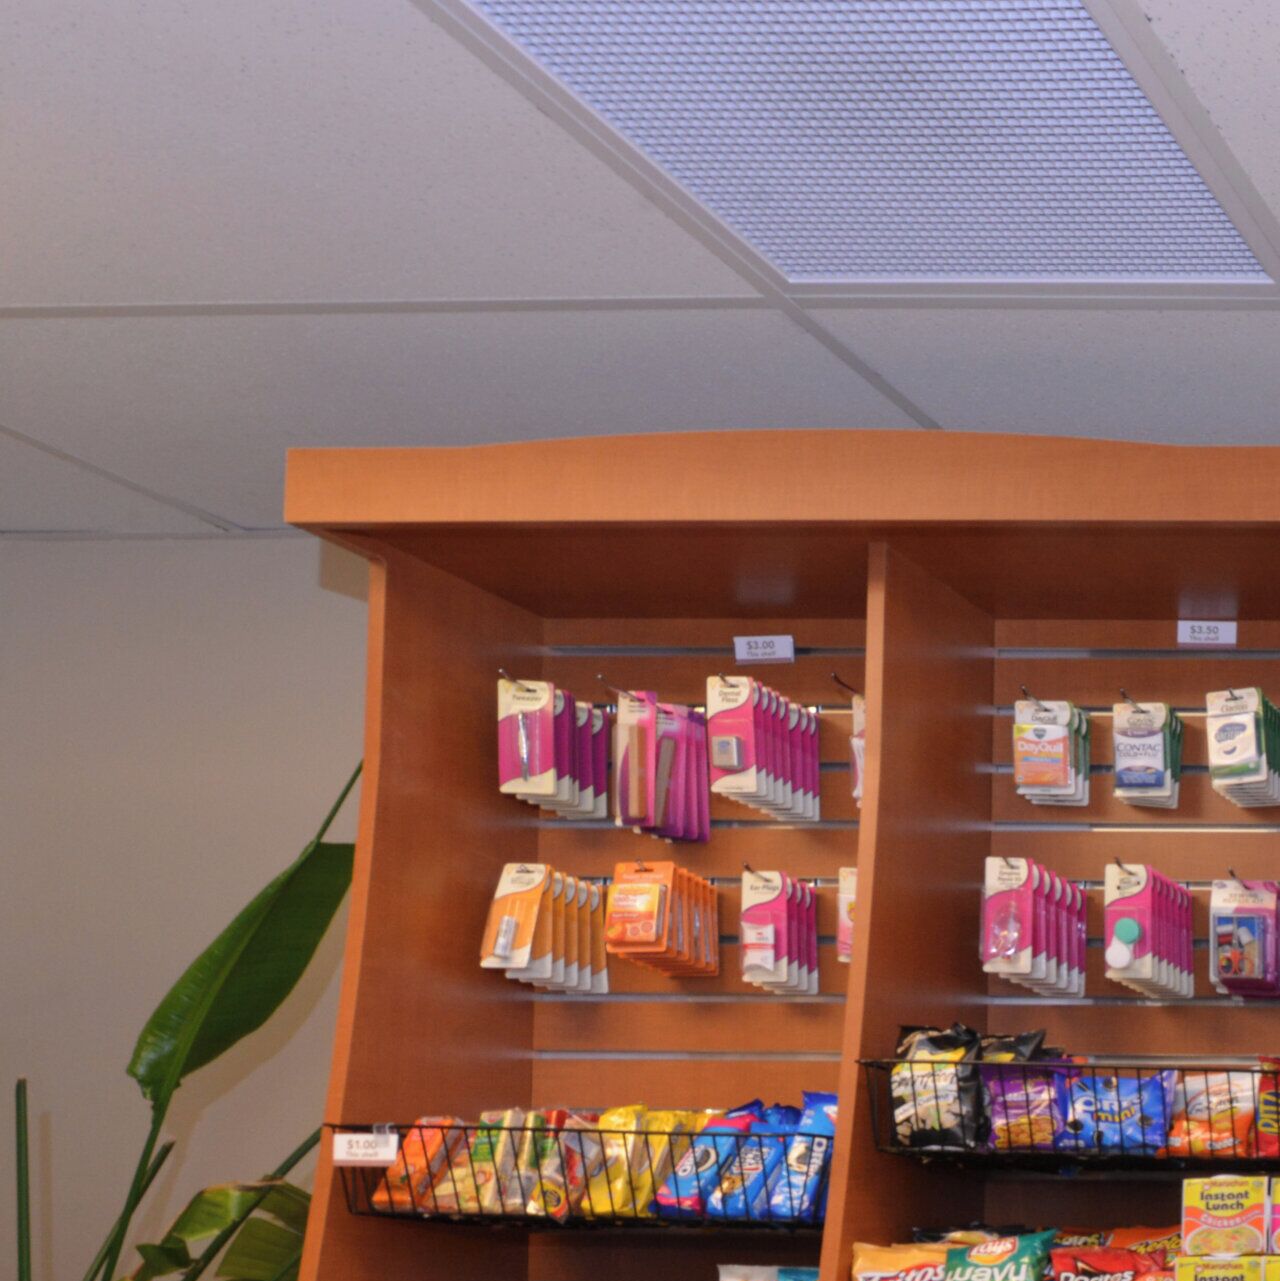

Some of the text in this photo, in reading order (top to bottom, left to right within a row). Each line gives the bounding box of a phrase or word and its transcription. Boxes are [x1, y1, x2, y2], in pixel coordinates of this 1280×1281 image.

[1190, 626, 1219, 635] $3.50
[1200, 1190, 1249, 1200] Instant
[1206, 1201, 1245, 1211] Lunch
